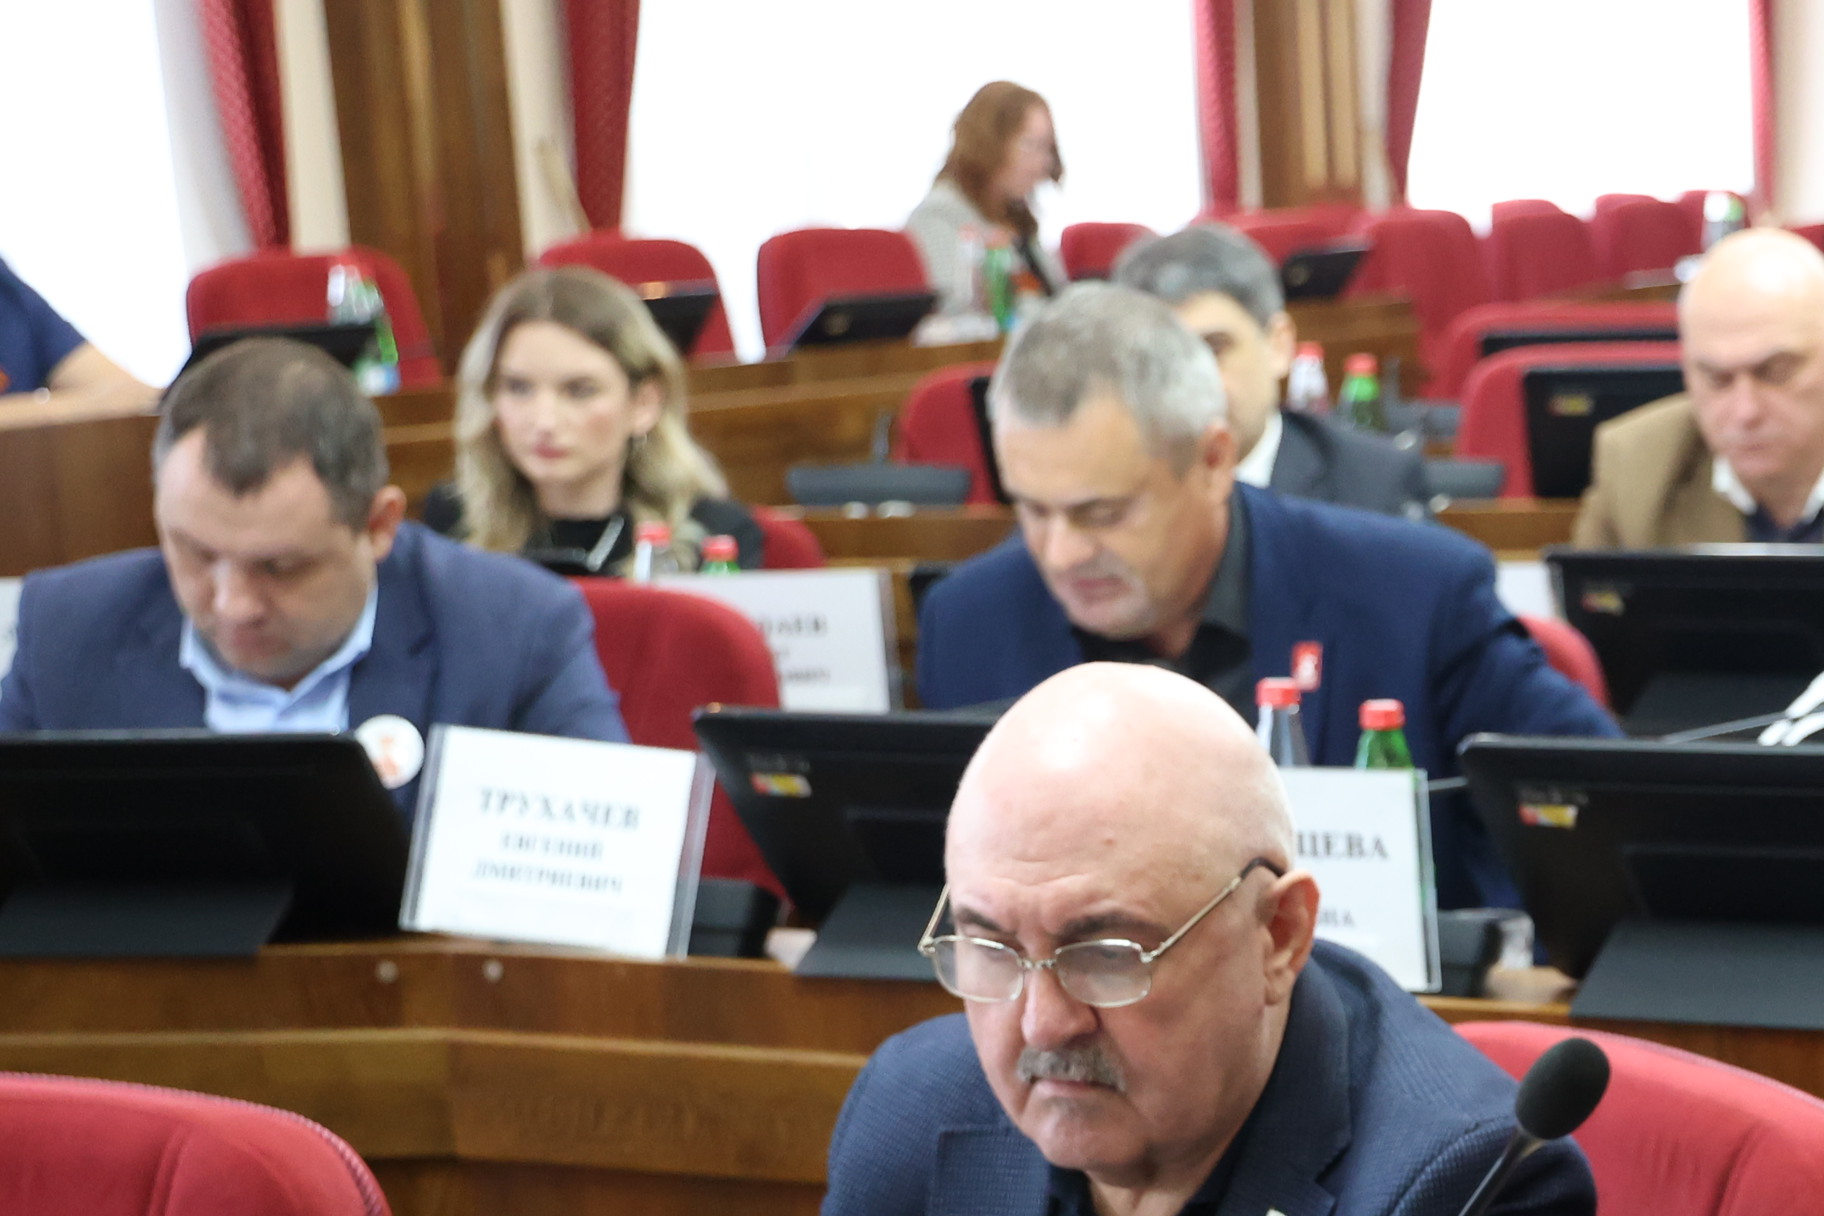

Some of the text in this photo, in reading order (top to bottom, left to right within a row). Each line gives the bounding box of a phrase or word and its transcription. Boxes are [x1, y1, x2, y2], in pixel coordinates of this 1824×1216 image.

[479, 785, 641, 830] ТРУХАЧЕВ
[501, 831, 604, 860] ЕВГЕНИЙ
[1297, 829, 1390, 861] ЦЕВА
[472, 858, 624, 895] ДМИТРИЕВИЧ
